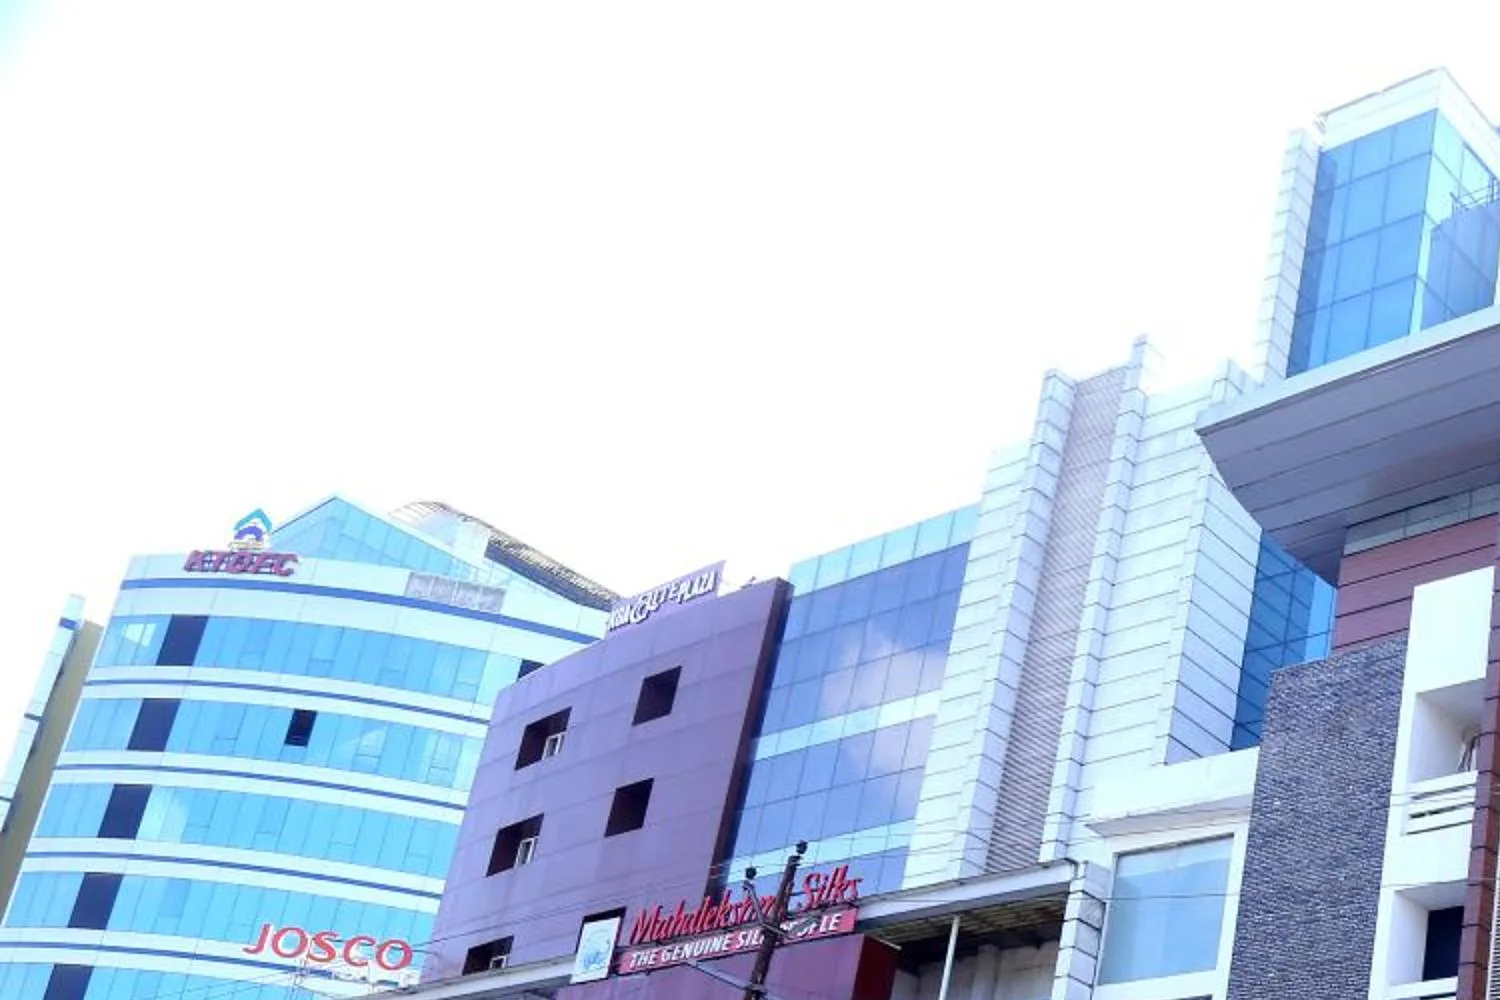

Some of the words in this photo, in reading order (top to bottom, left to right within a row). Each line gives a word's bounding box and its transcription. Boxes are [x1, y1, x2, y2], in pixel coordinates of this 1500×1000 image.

[799, 863, 863, 913] Silks
[242, 923, 414, 972] JOSCO
[629, 949, 657, 970] THE
[660, 933, 733, 964] GENUINE
